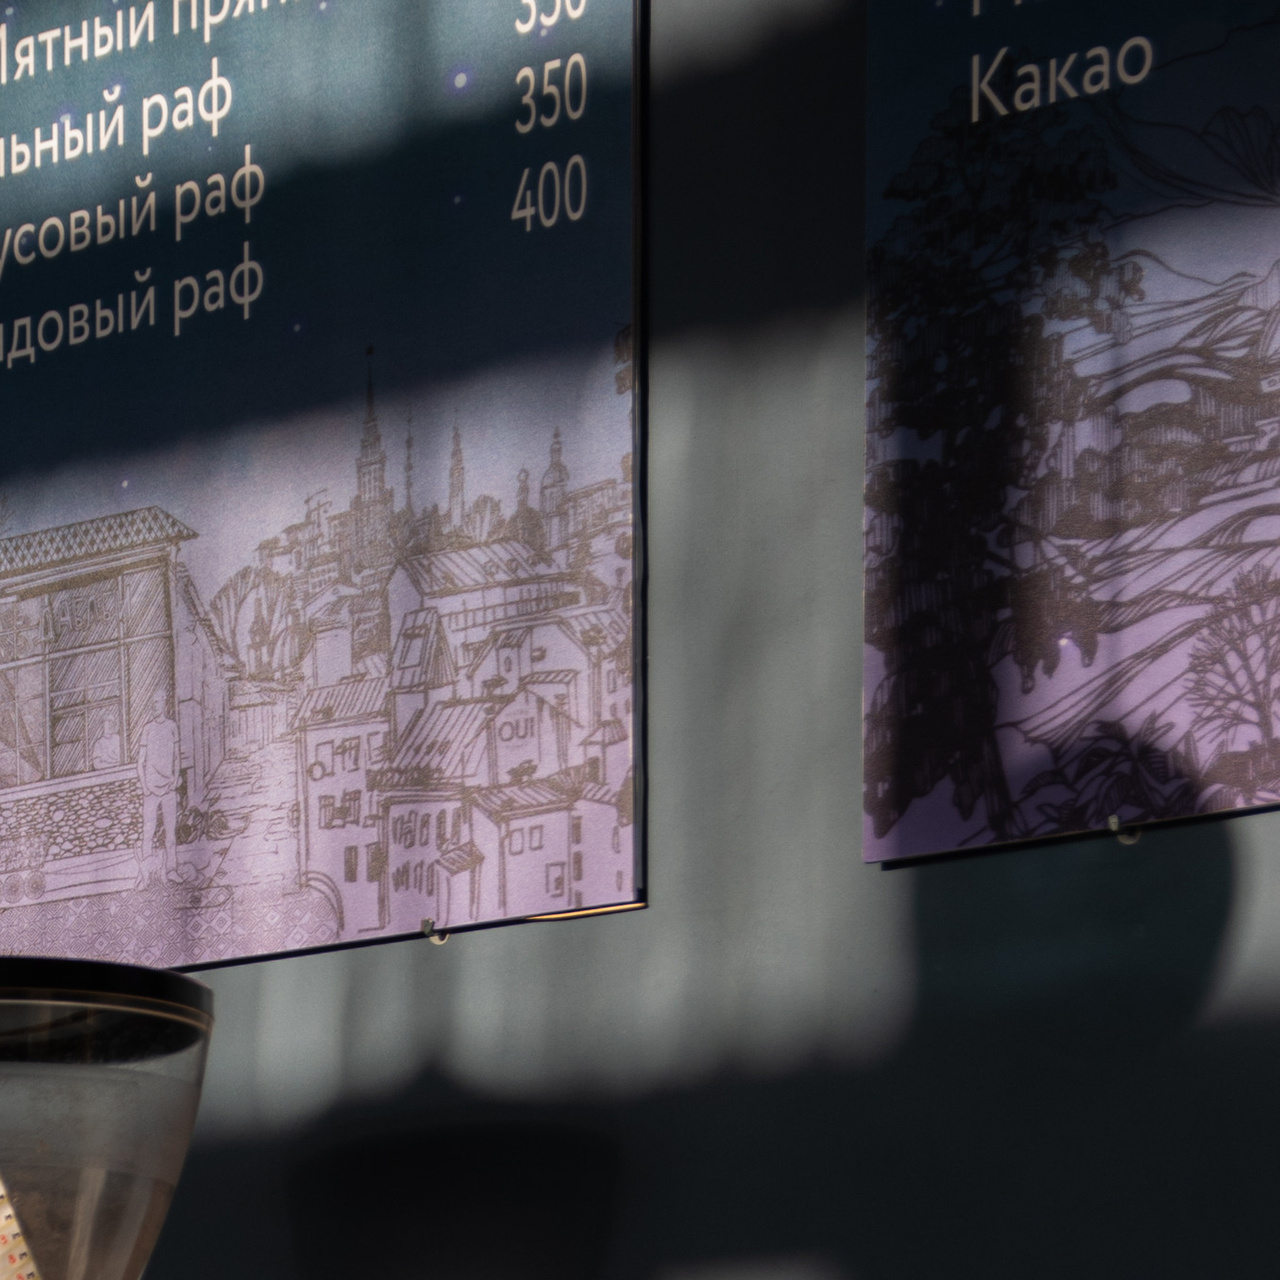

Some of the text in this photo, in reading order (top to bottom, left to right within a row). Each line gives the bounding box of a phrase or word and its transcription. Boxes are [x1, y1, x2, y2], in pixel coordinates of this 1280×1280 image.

[142, 57, 233, 153] раф
[515, 52, 587, 134] 350
[971, 36, 1153, 123] Какао
[175, 145, 264, 243] раф
[510, 154, 587, 233] 400
[174, 242, 264, 337] раф
